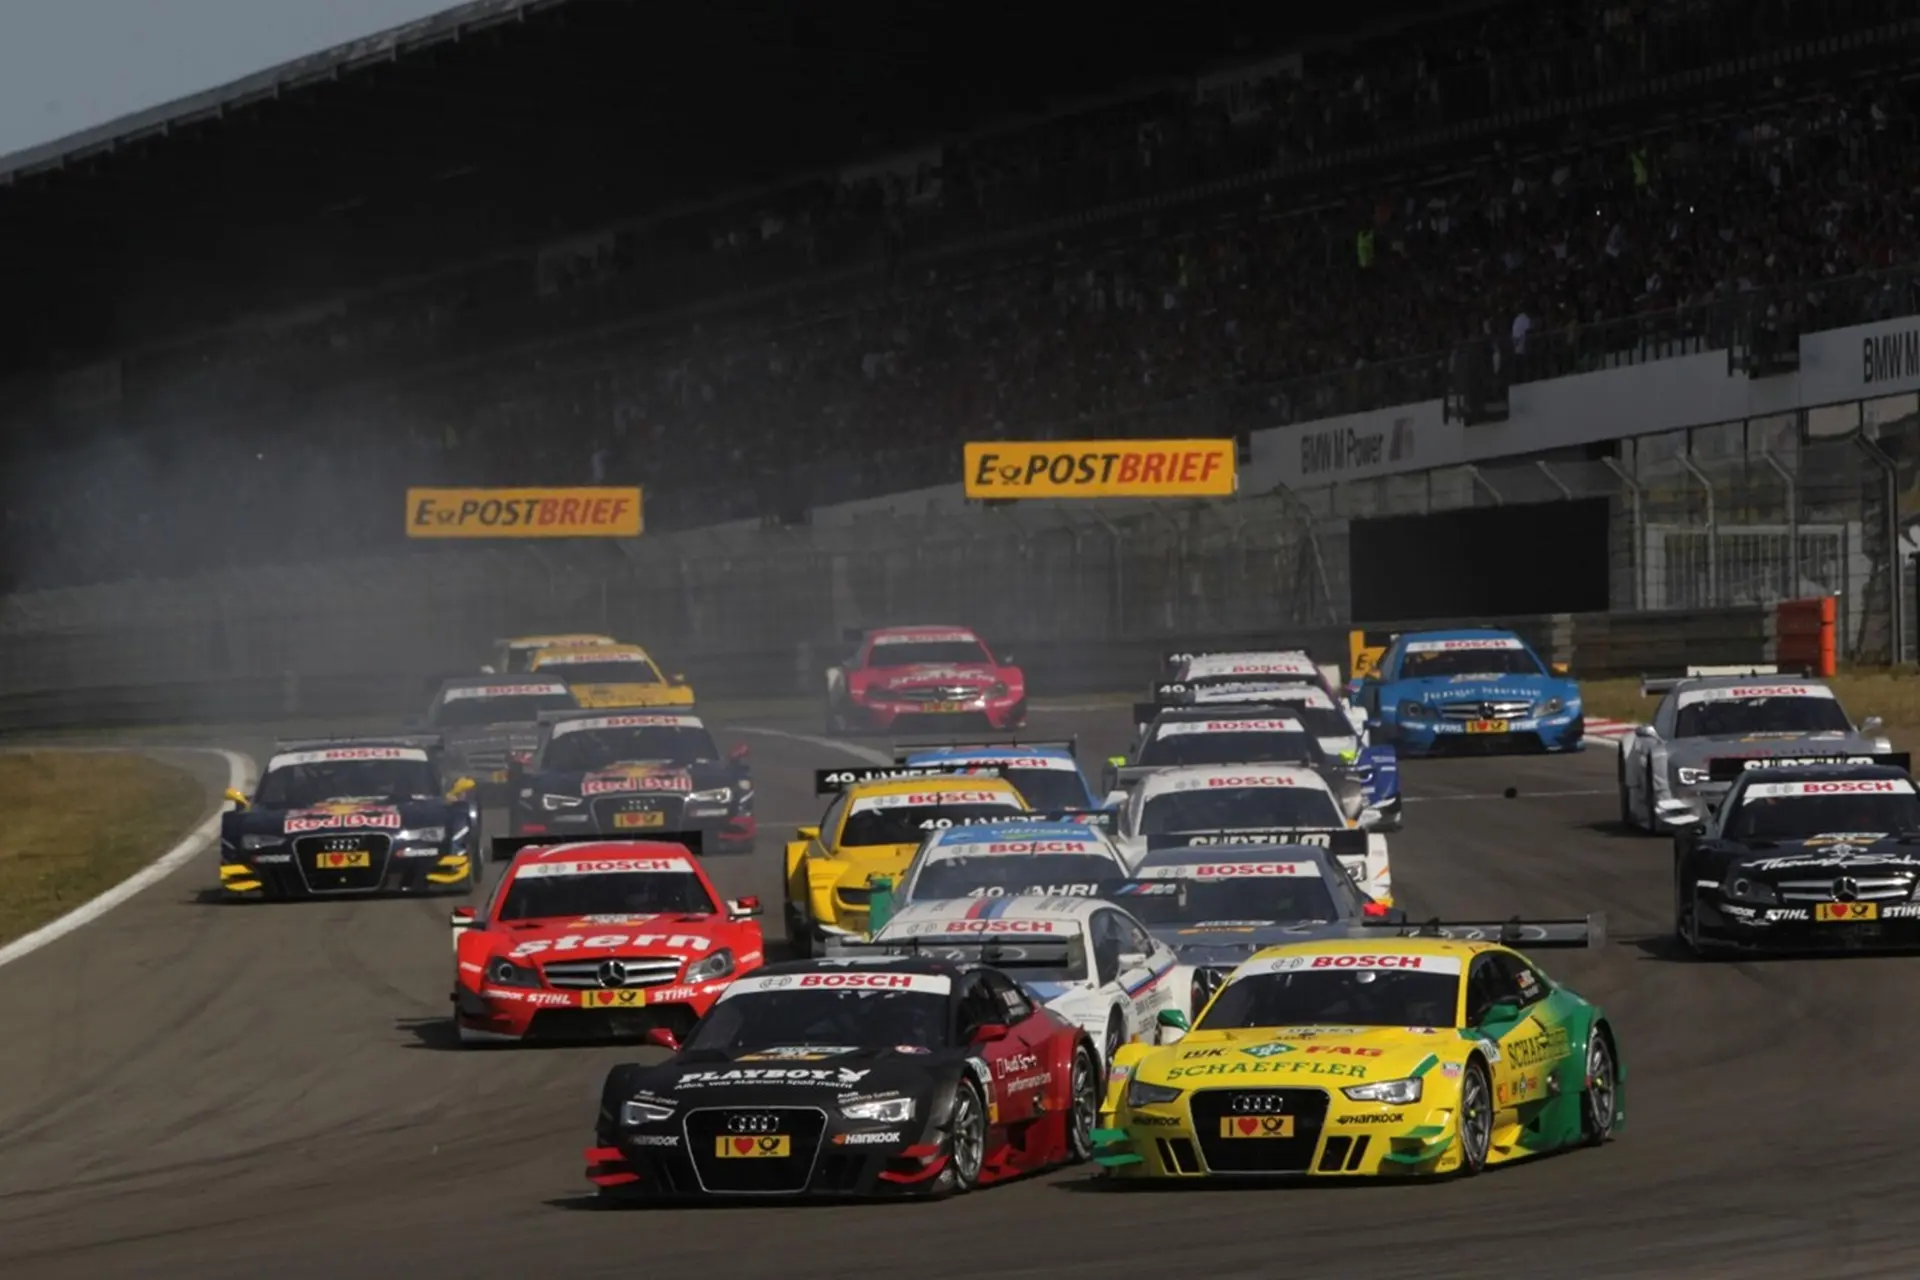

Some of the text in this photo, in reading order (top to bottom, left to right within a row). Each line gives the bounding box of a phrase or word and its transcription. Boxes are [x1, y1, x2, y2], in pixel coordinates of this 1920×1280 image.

[1863, 331, 1903, 384] BMW
[1302, 431, 1332, 476] BMW
[1024, 452, 1224, 485] POSTBRIEF
[458, 497, 632, 526] POSTBRIEF
[1444, 639, 1507, 648] BOSCH
[1232, 664, 1299, 673] BOSCH
[485, 683, 551, 695] BOSCH
[1159, 683, 1186, 694] 40
[1732, 685, 1807, 697] BOSCH
[606, 715, 679, 726] BOSCH
[1206, 720, 1285, 731] BOSCH
[325, 748, 401, 760] BOSCH
[824, 771, 855, 783] 40
[1208, 776, 1295, 787] BOSCH
[583, 778, 692, 794] Red Bull
[1803, 780, 1894, 793] BOSCH
[908, 791, 996, 805] BOSCH
[286, 813, 400, 833] Red Bull
[919, 817, 953, 830] 40
[988, 842, 1085, 854] BOSCH
[575, 859, 671, 874] BOSCH
[1196, 864, 1296, 876] BOSCH
[967, 885, 1004, 898] 40
[1765, 909, 1810, 920] STIHL
[945, 919, 1053, 932] BOSCH
[509, 933, 711, 958] stern
[1311, 955, 1422, 968] BOSCH
[799, 974, 912, 988] BOSCH
[527, 991, 572, 1005] STIHL
[653, 986, 698, 1002] STIHL
[1304, 1045, 1384, 1057] FAG
[678, 1069, 835, 1084] PLAYBOY
[1166, 1061, 1367, 1081] SCHAEFFLER
